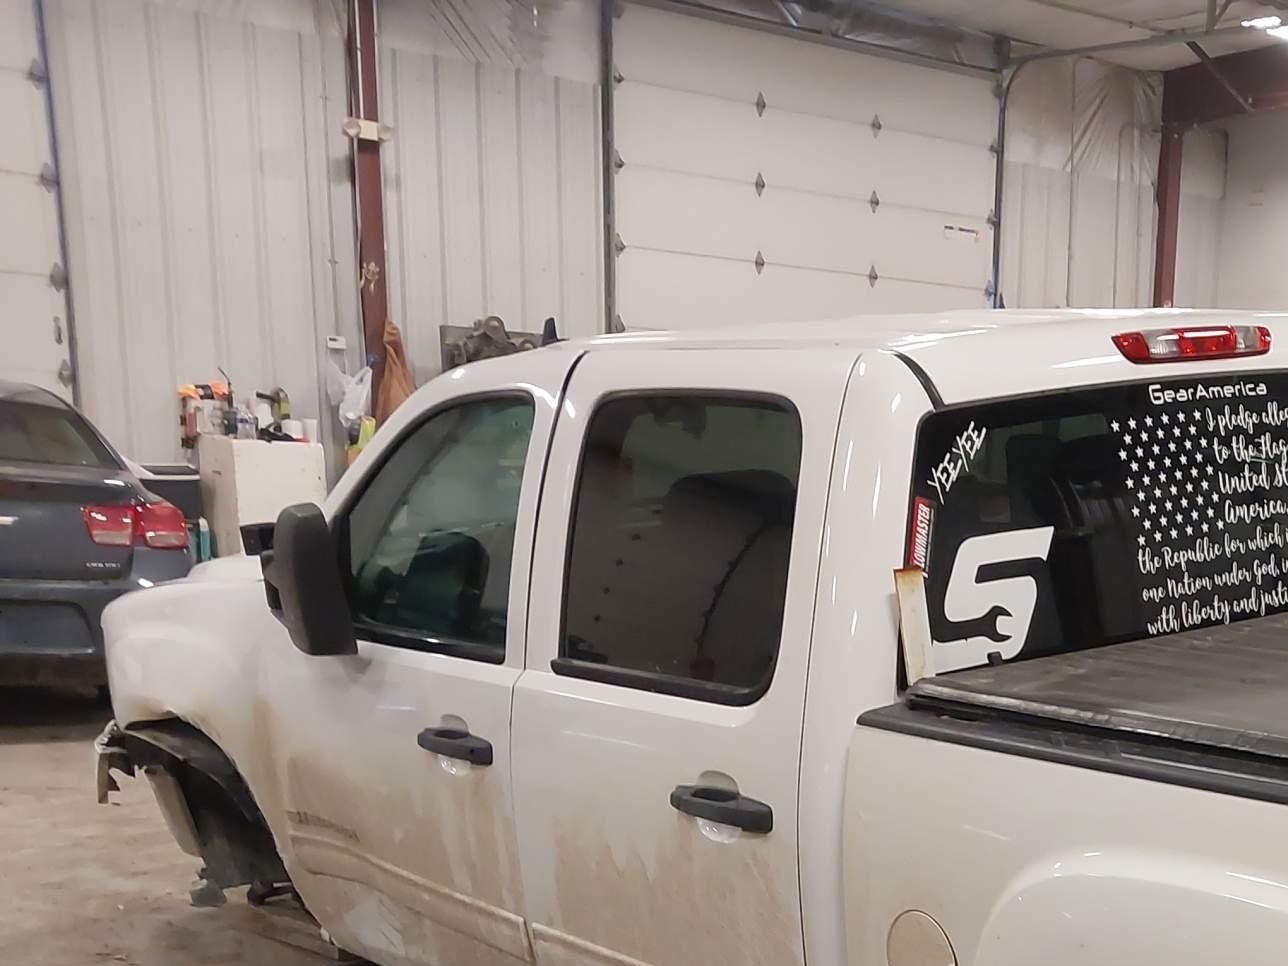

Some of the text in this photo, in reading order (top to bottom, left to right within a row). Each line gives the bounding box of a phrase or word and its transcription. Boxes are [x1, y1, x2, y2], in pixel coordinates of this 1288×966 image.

[1148, 381, 1267, 405] GearAmerica
[1205, 407, 1216, 432] I
[1217, 404, 1260, 436] pledge
[1212, 436, 1230, 464] to
[1231, 434, 1256, 463] the
[1218, 463, 1270, 494] United
[1138, 547, 1162, 574] the
[1160, 536, 1223, 571] Republic
[1224, 532, 1246, 558] for
[1248, 522, 1284, 551] which
[1142, 586, 1166, 603] one
[1166, 571, 1213, 599] Nation
[1214, 561, 1251, 586] under
[1147, 604, 1181, 635] with
[1181, 594, 1231, 625] liberty
[1233, 586, 1259, 614] and
